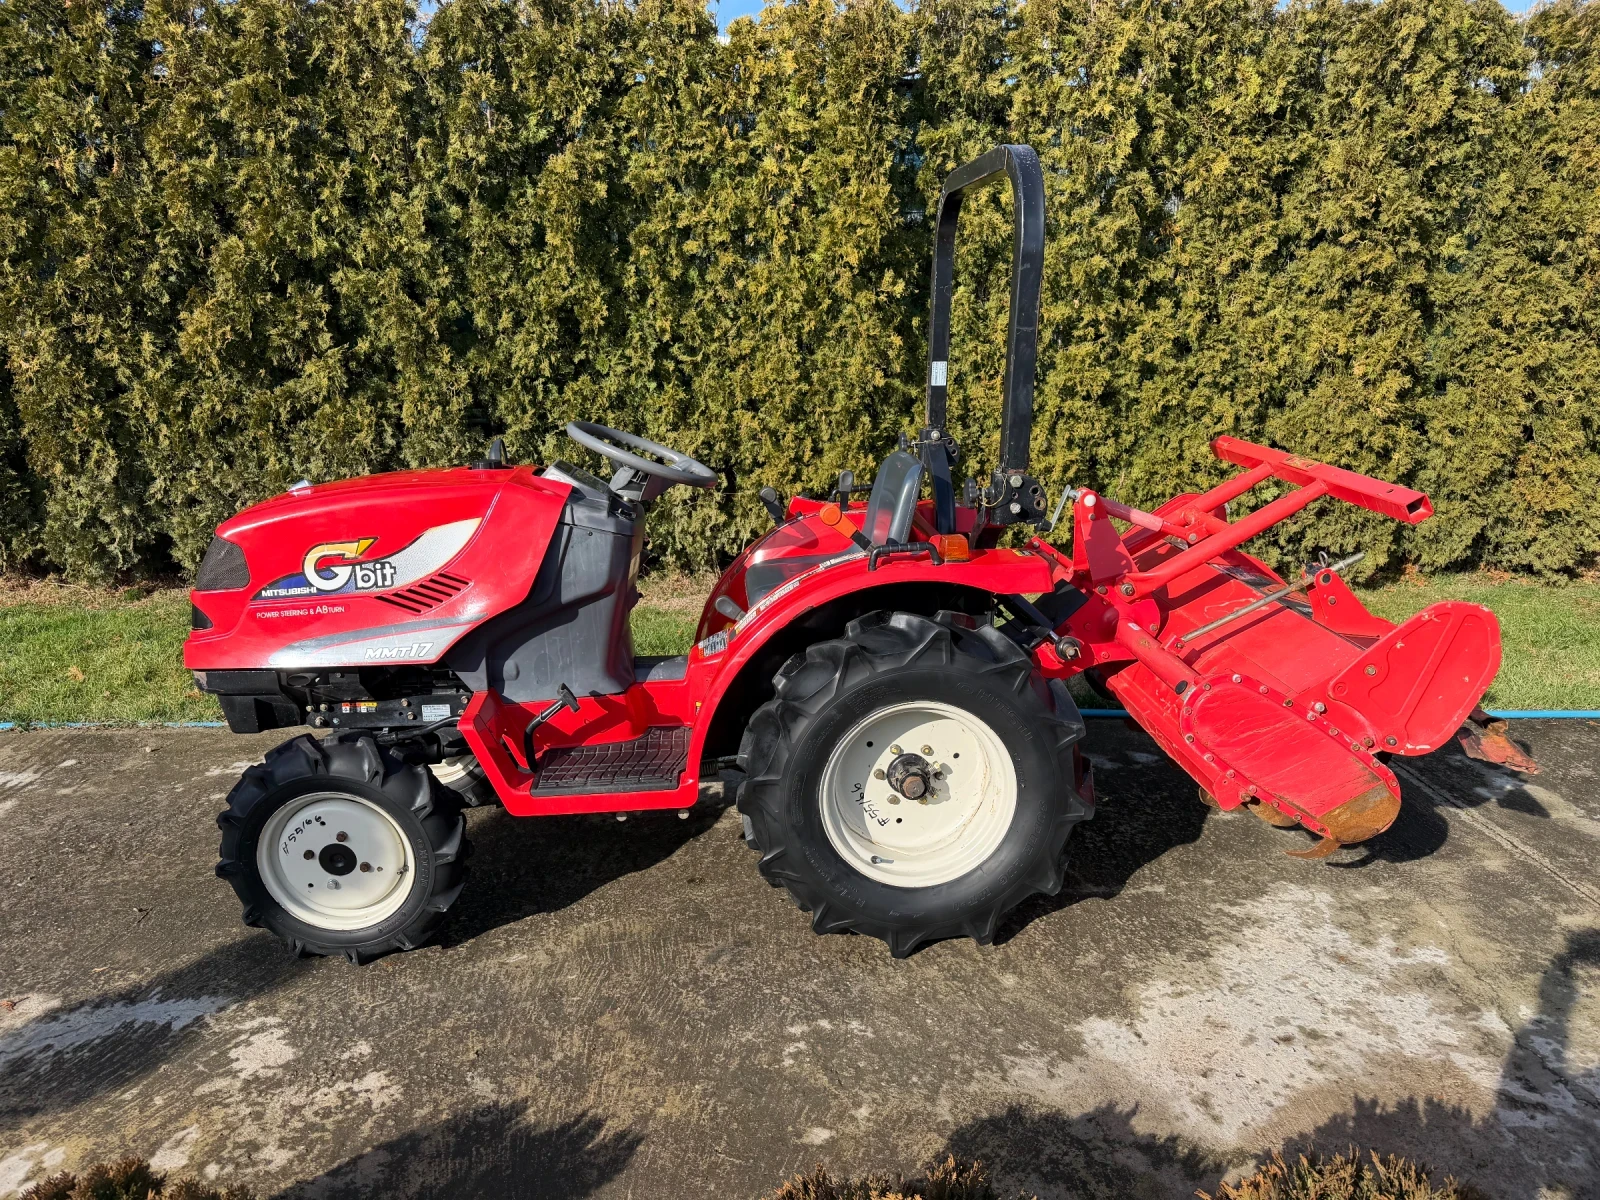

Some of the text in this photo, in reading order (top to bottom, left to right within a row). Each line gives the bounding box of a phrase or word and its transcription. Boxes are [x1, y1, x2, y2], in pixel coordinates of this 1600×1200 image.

[261, 586, 318, 597] MITSUBISHI
[256, 610, 280, 619] POWER
[280, 608, 308, 617] STEERING
[364, 642, 435, 659] MMT17
